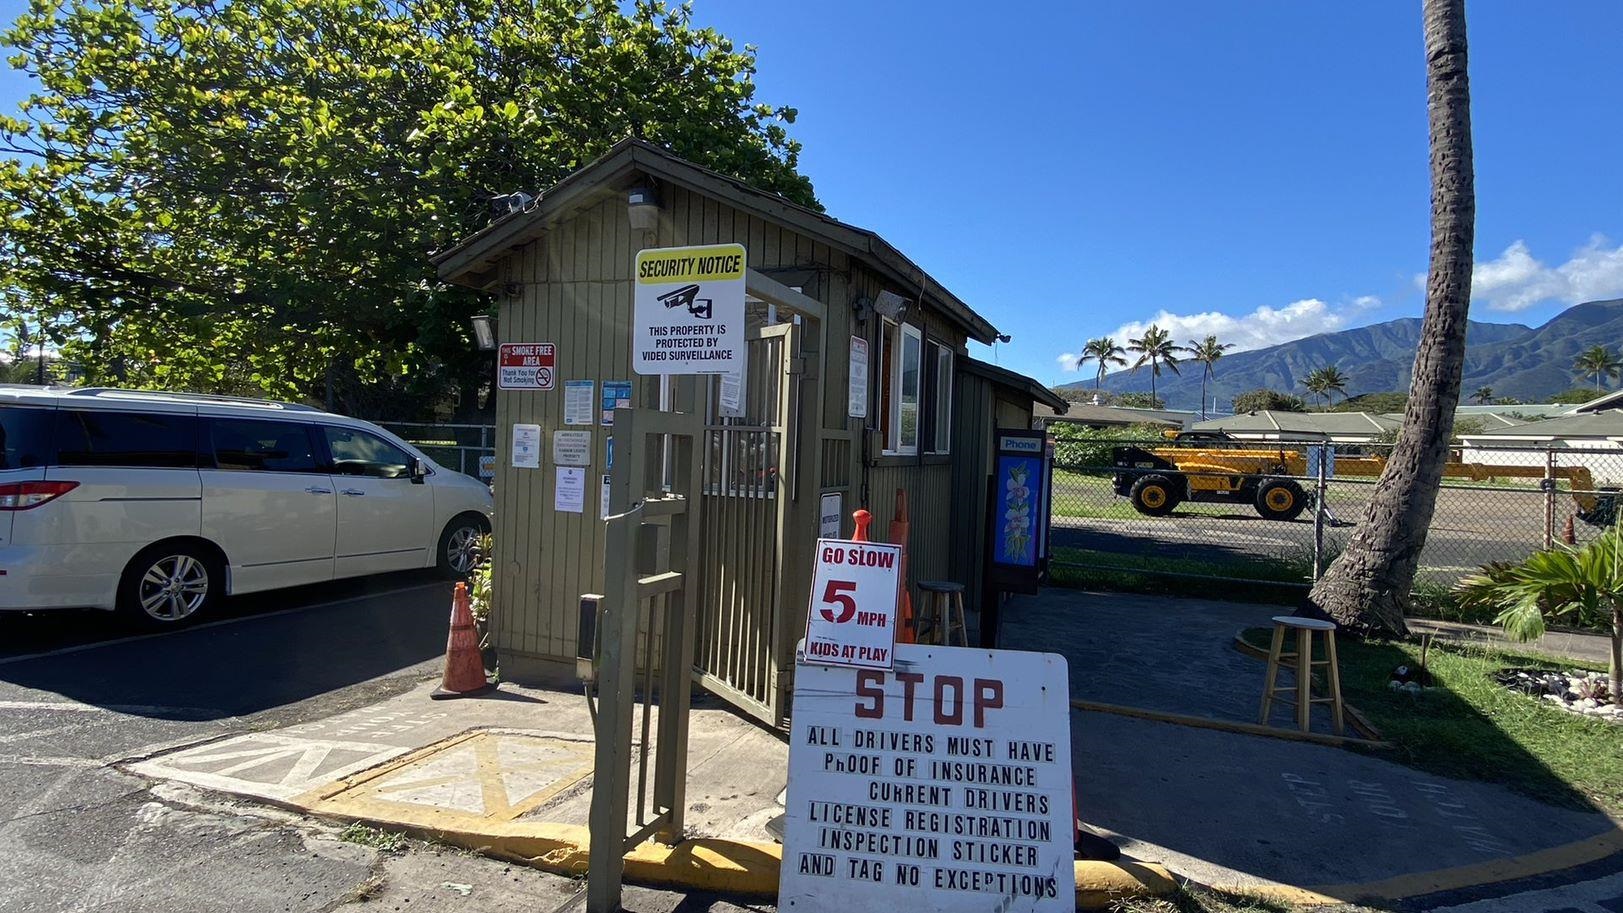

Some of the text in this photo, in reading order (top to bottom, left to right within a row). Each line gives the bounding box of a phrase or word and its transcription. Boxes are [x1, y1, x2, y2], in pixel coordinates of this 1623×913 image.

[640, 255, 741, 278] SECURITY NOTICE
[649, 324, 726, 336] THIS PROPERTY IS
[511, 346, 552, 356] SMOKE FREE
[655, 337, 719, 348] PROTECTED BY
[522, 356, 541, 366] AREA
[642, 349, 732, 361] VIDEO SURVEILLANCE
[513, 377, 535, 385] Smoking
[1005, 438, 1037, 450] Phone
[822, 547, 895, 569] GO SLOW
[819, 580, 857, 624] 5
[857, 611, 887, 627] MPH
[810, 641, 888, 662] KIDS AT PLAY
[854, 670, 1004, 728] STOP
[808, 727, 1054, 762] ALL DRIVERS MUST HAVE
[894, 758, 916, 777] OF
[931, 761, 1036, 786] INSURANCE
[869, 782, 1049, 815] CURRENT DRIVERS
[809, 802, 1051, 841] LICENSE REGISTRATION
[820, 829, 1038, 866] INSPECTION STICKER
[800, 854, 1058, 898] AND TAG NO EXCEPTIONS
